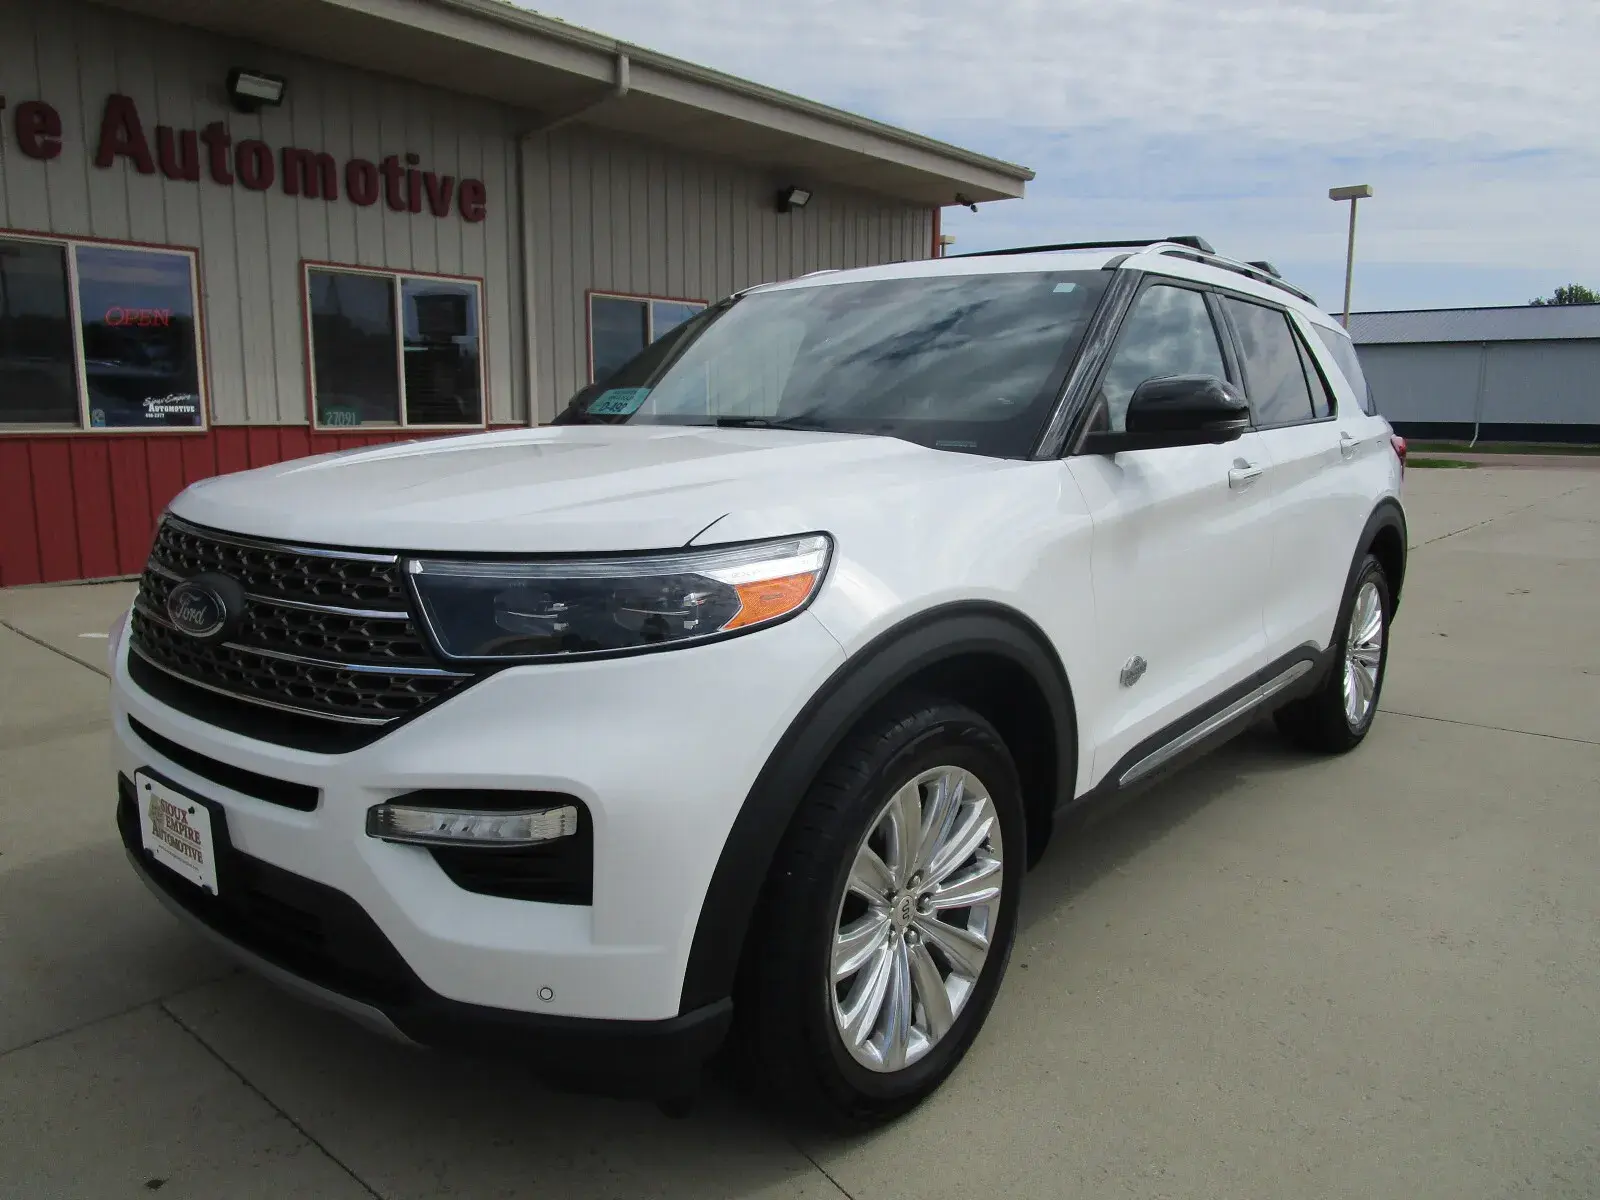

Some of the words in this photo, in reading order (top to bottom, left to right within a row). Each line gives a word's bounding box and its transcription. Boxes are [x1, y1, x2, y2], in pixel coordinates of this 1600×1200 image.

[95, 93, 487, 223] Automotive
[106, 307, 168, 326] OPEN
[148, 402, 195, 413] AUTOMOTIVE
[325, 411, 357, 427] 27091
[175, 592, 208, 625] Ford
[160, 798, 189, 825] SIOUX
[152, 819, 204, 865] AUTOMOTIVE
[166, 815, 202, 846] EMPIRE
